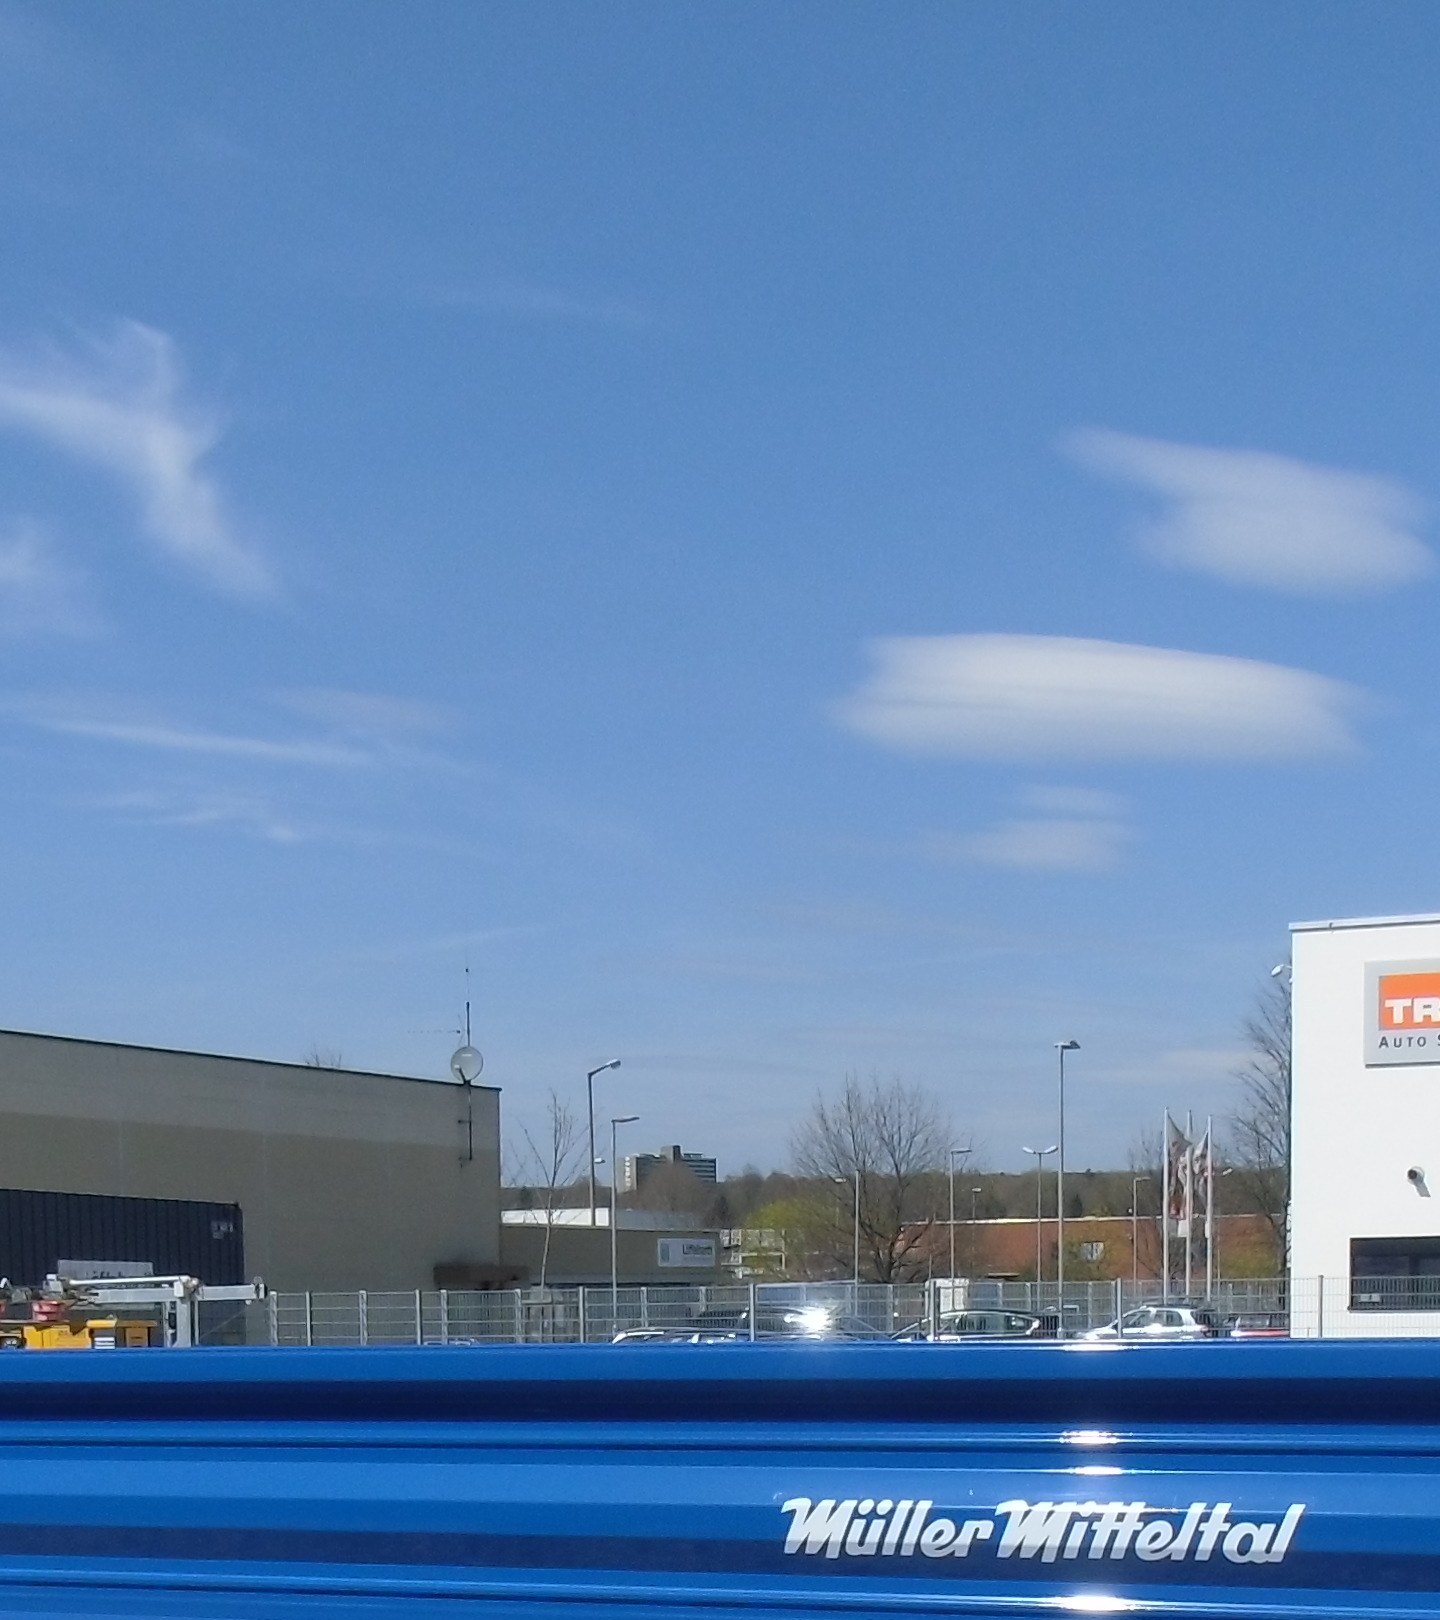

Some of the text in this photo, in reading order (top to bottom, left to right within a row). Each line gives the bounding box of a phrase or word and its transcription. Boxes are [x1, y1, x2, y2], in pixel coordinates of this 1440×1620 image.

[1379, 1035, 1427, 1049] AUTO
[781, 1497, 1306, 1564] Müller Mitteltal
